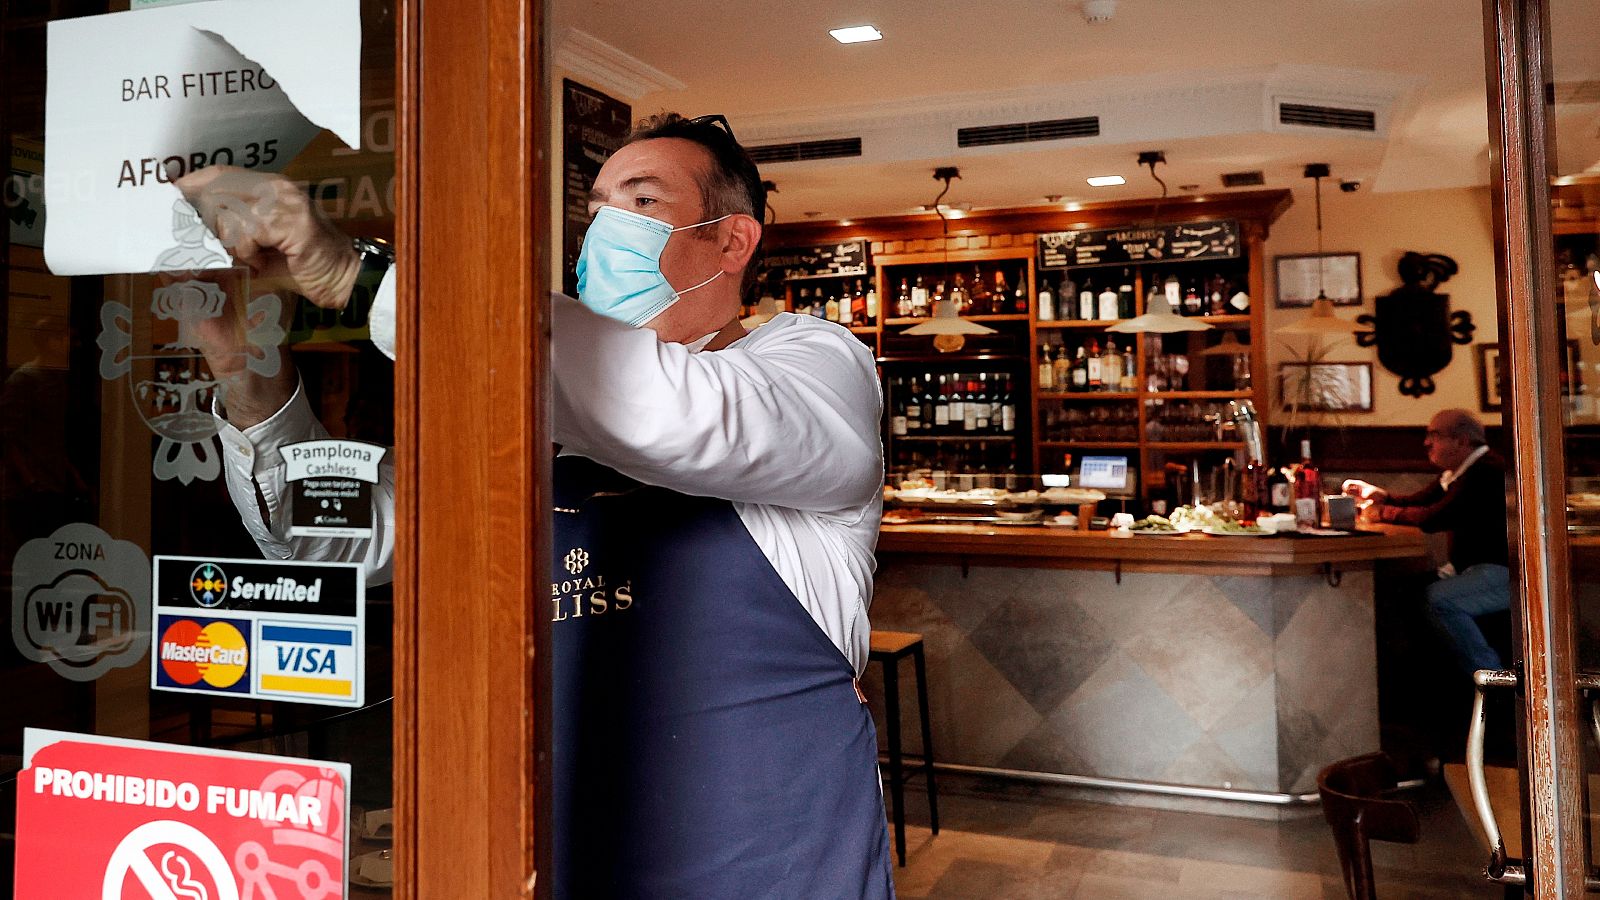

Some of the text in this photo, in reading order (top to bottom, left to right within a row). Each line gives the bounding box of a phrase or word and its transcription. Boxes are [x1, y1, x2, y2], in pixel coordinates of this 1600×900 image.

[122, 69, 275, 102] BAR FITERO
[243, 139, 278, 169] 35
[292, 444, 371, 461] Pamplona
[306, 463, 357, 476] Cashless
[54, 542, 106, 561] ZONA
[230, 576, 322, 603] ServiRed
[552, 575, 606, 596] ROYAL
[162, 641, 246, 666] MasterCard
[276, 646, 337, 674] VISA
[34, 766, 322, 827] PROHIBIDO FUMAR
